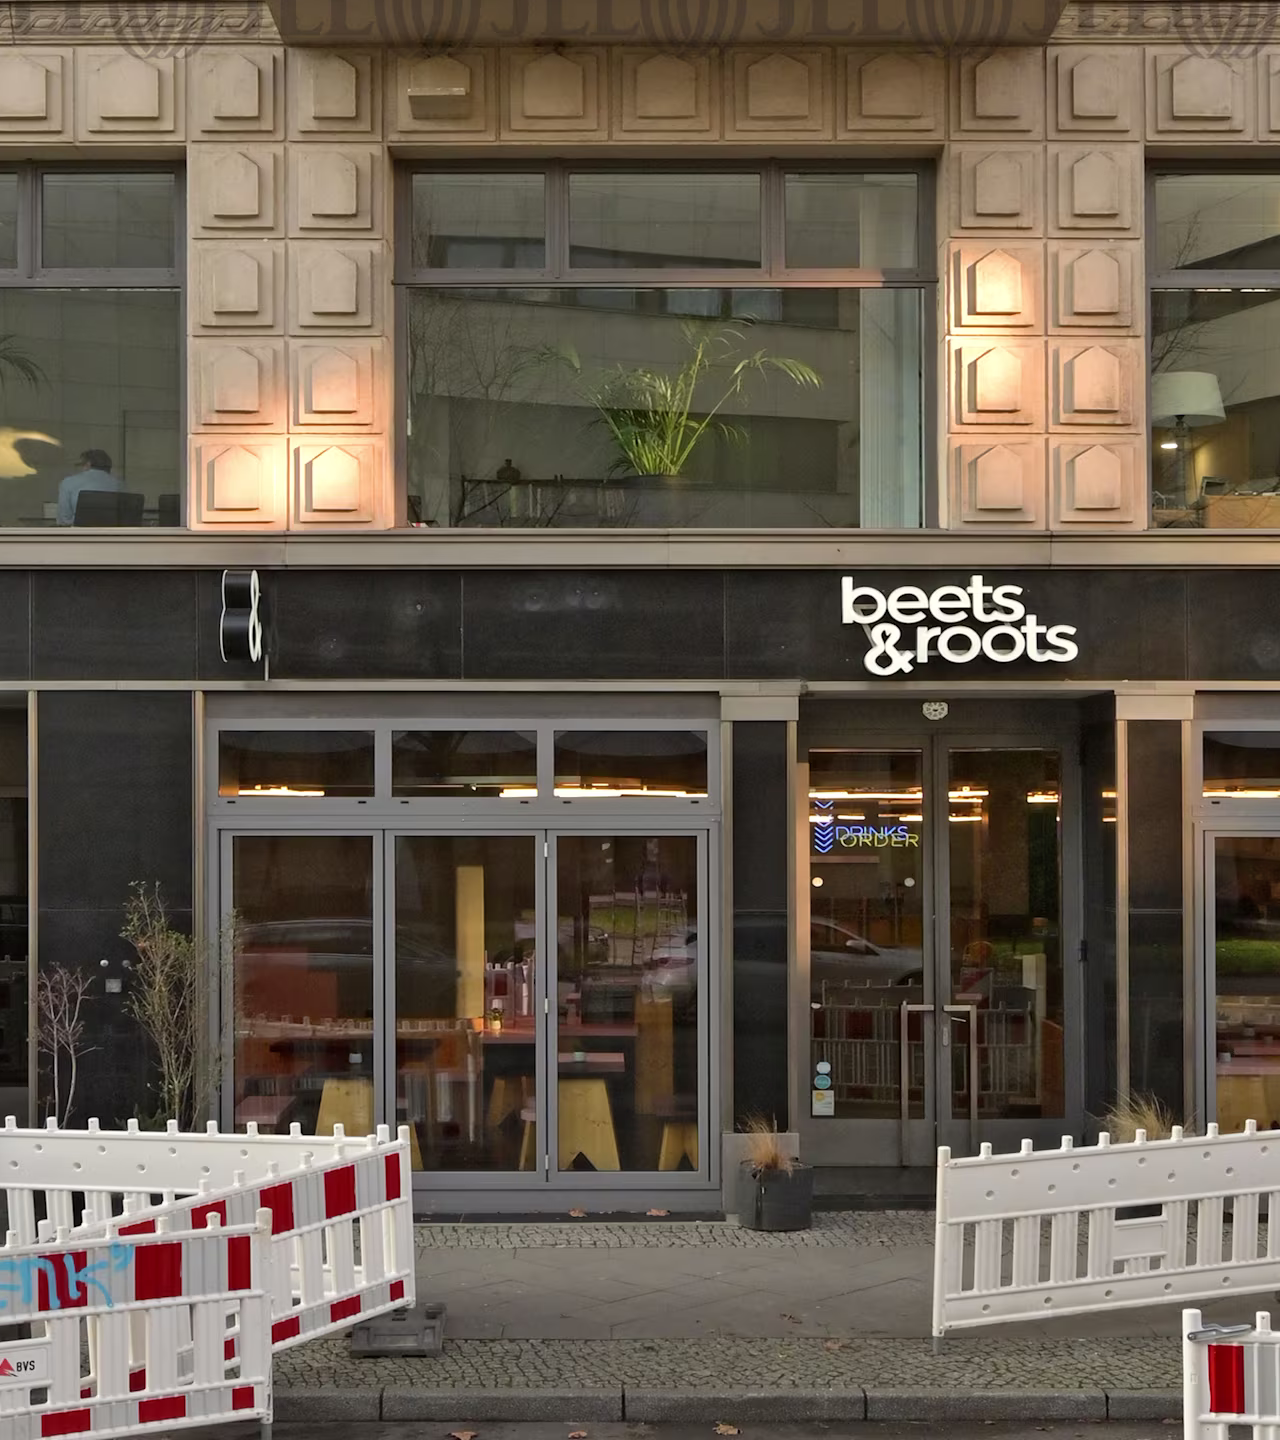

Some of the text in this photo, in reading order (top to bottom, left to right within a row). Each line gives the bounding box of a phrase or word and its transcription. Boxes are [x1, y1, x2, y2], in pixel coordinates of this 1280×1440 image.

[841, 575, 1026, 624] beets
[836, 826, 908, 841] DRINKS
[840, 833, 919, 847] ORDER
[16, 1360, 36, 1372] BVS
